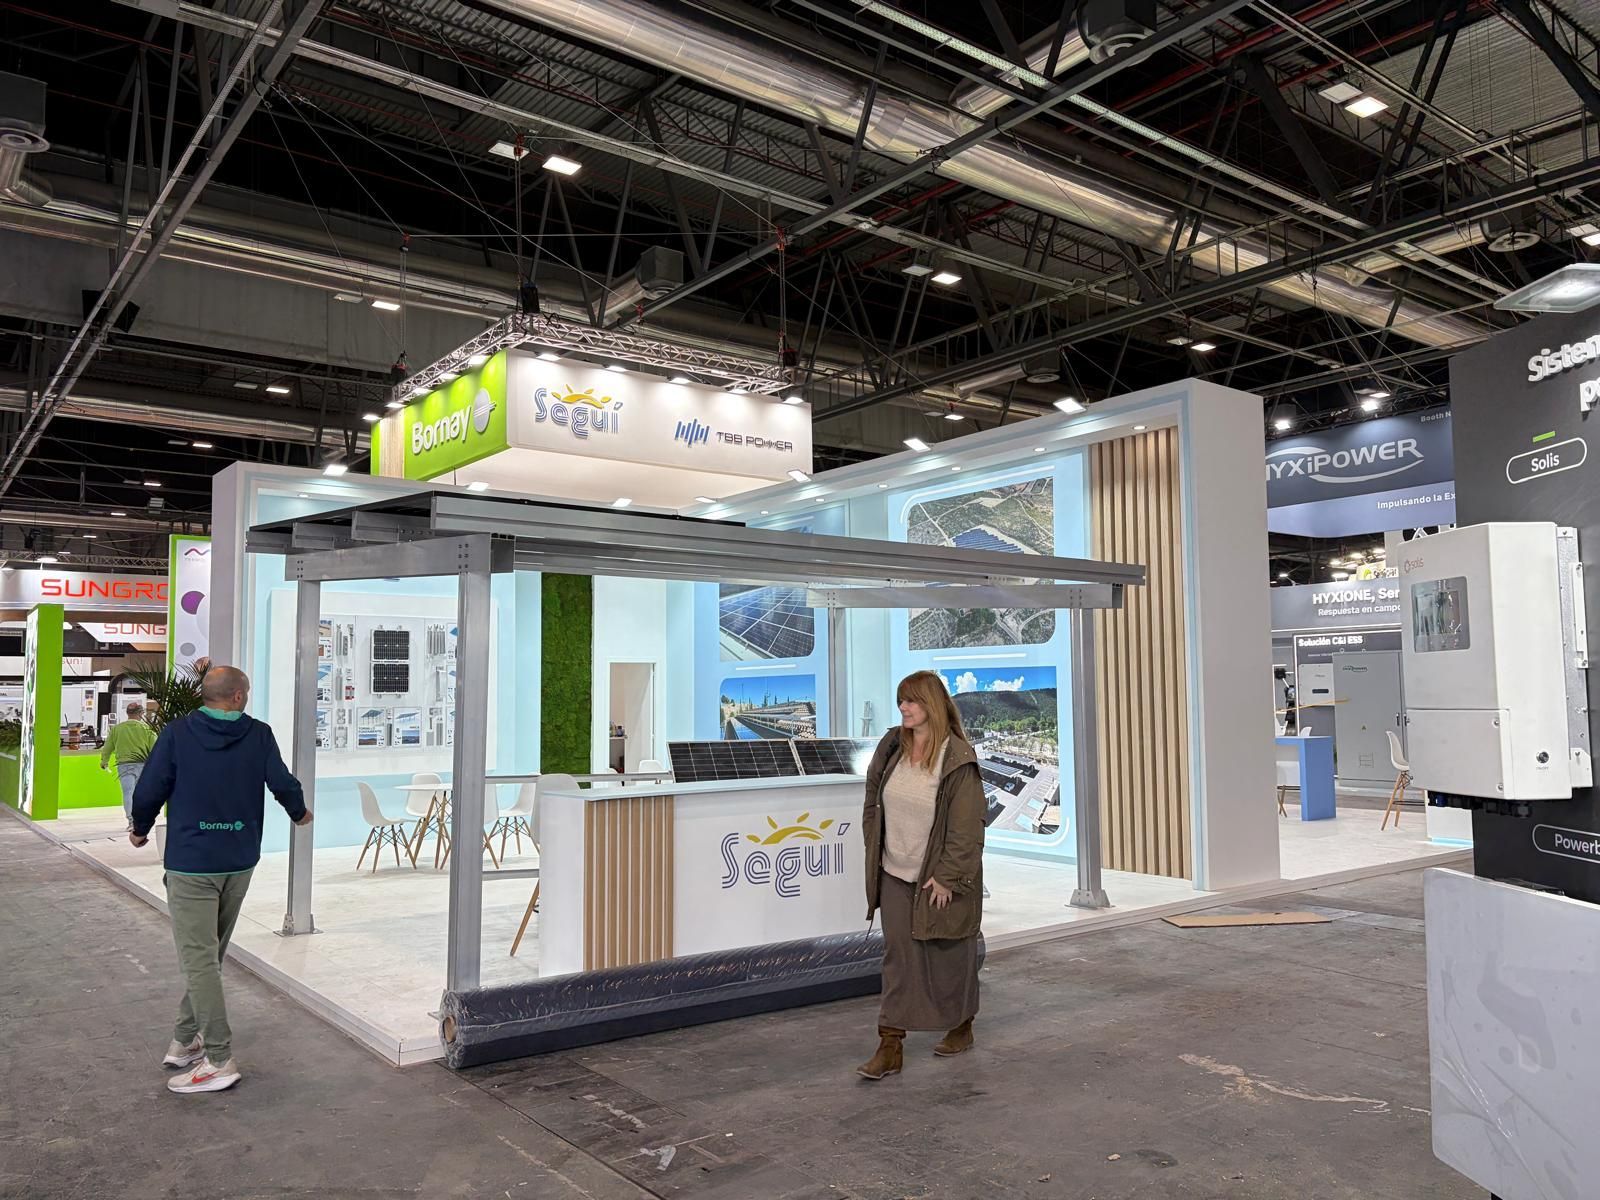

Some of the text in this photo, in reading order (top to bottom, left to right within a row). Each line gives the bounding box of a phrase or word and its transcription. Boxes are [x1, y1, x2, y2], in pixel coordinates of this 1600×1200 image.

[1580, 377, 1600, 412] p
[1420, 412, 1444, 422] Booth
[411, 405, 472, 454] Bornay
[716, 431, 793, 452] TBB POWER
[1531, 452, 1560, 472] Solis
[1377, 495, 1432, 509] Impulsando
[1433, 494, 1443, 502] la
[1312, 587, 1400, 604] HYXIONE, Ser
[1318, 606, 1360, 616] Respuesta
[1298, 636, 1331, 647] Solución
[1347, 635, 1363, 645] ESS
[199, 821, 234, 831] Bornay
